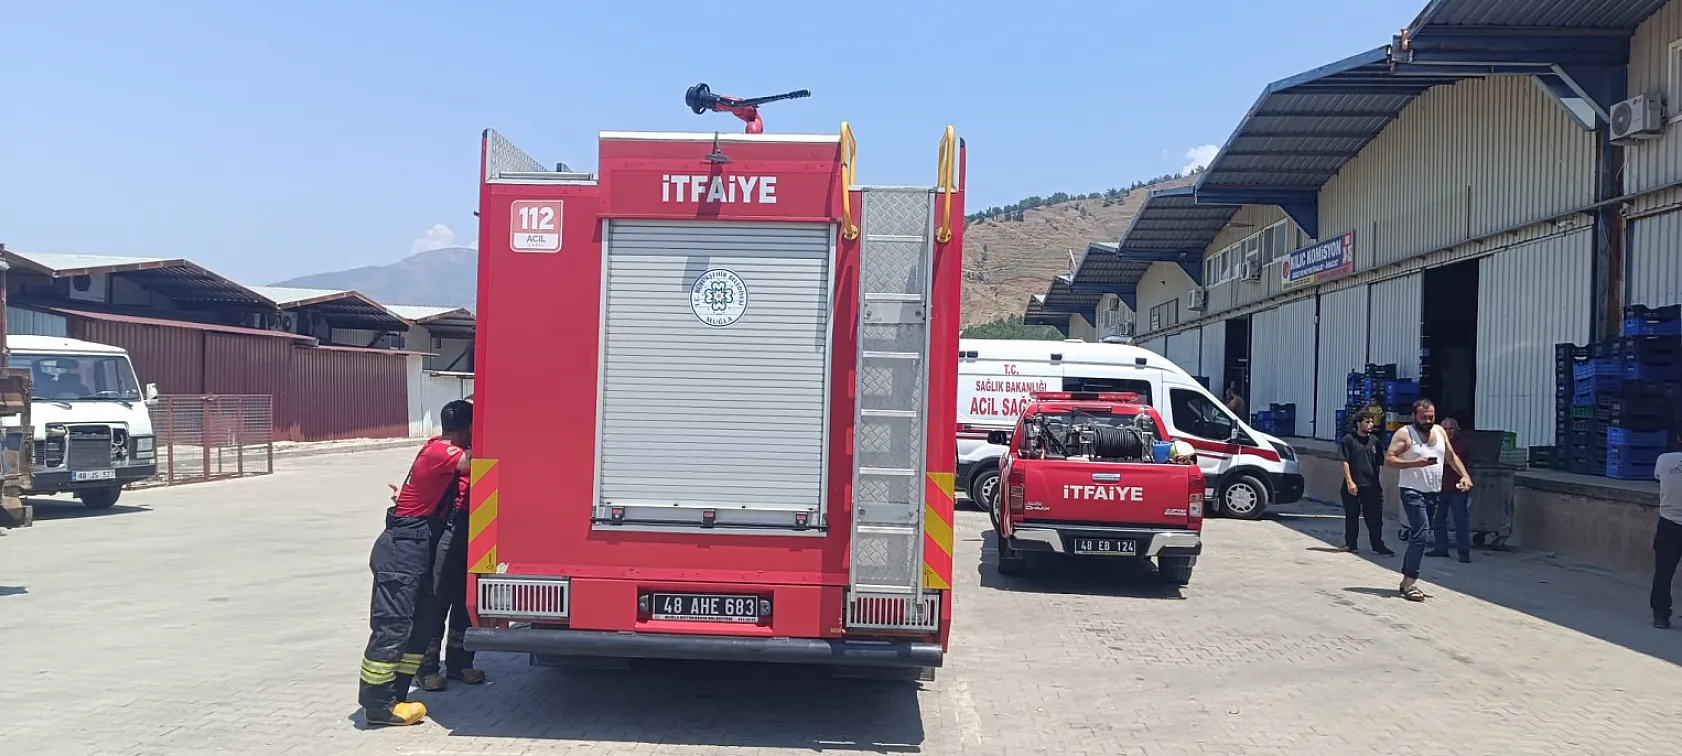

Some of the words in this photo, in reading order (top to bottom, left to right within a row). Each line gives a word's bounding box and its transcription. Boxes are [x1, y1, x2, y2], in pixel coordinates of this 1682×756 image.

[518, 206, 554, 230] 112
[1003, 364, 1020, 376] T.C.
[975, 378, 1004, 392] SAĞLIK
[1005, 379, 1047, 393] BAKANLIĞI
[1001, 395, 1030, 417] SAĞ
[1080, 540, 1092, 550] 48
[1098, 540, 1110, 551] EB
[1117, 541, 1133, 552] 124
[663, 596, 682, 614] 48
[690, 597, 720, 615] AHE
[725, 598, 755, 616] 683
